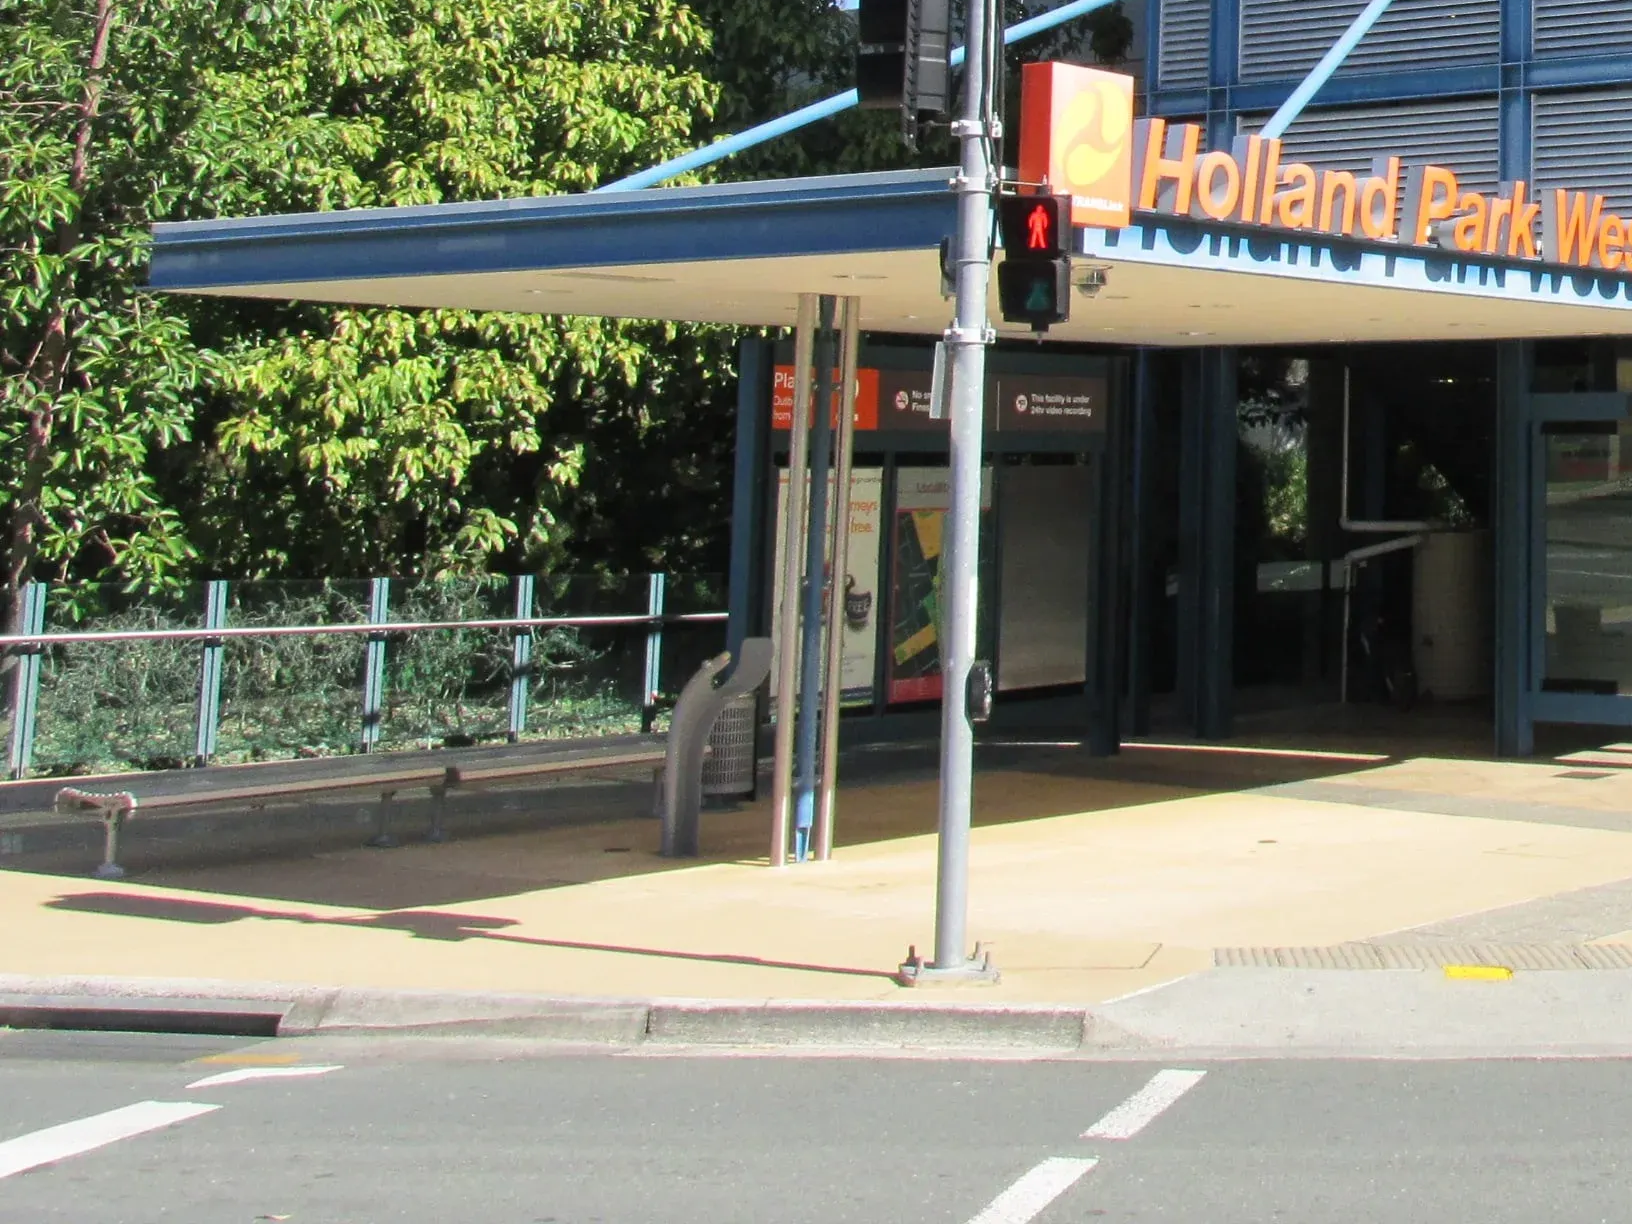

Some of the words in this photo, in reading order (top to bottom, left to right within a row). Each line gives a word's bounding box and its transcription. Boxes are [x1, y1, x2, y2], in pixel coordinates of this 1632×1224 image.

[1138, 117, 1400, 241] Holland
[1414, 165, 1540, 259] Park
[1031, 393, 1044, 403] This
[1045, 393, 1065, 405] facility
[1066, 393, 1071, 403] is
[1073, 394, 1090, 404] under
[1045, 405, 1063, 415] video
[1063, 406, 1092, 417] recording
